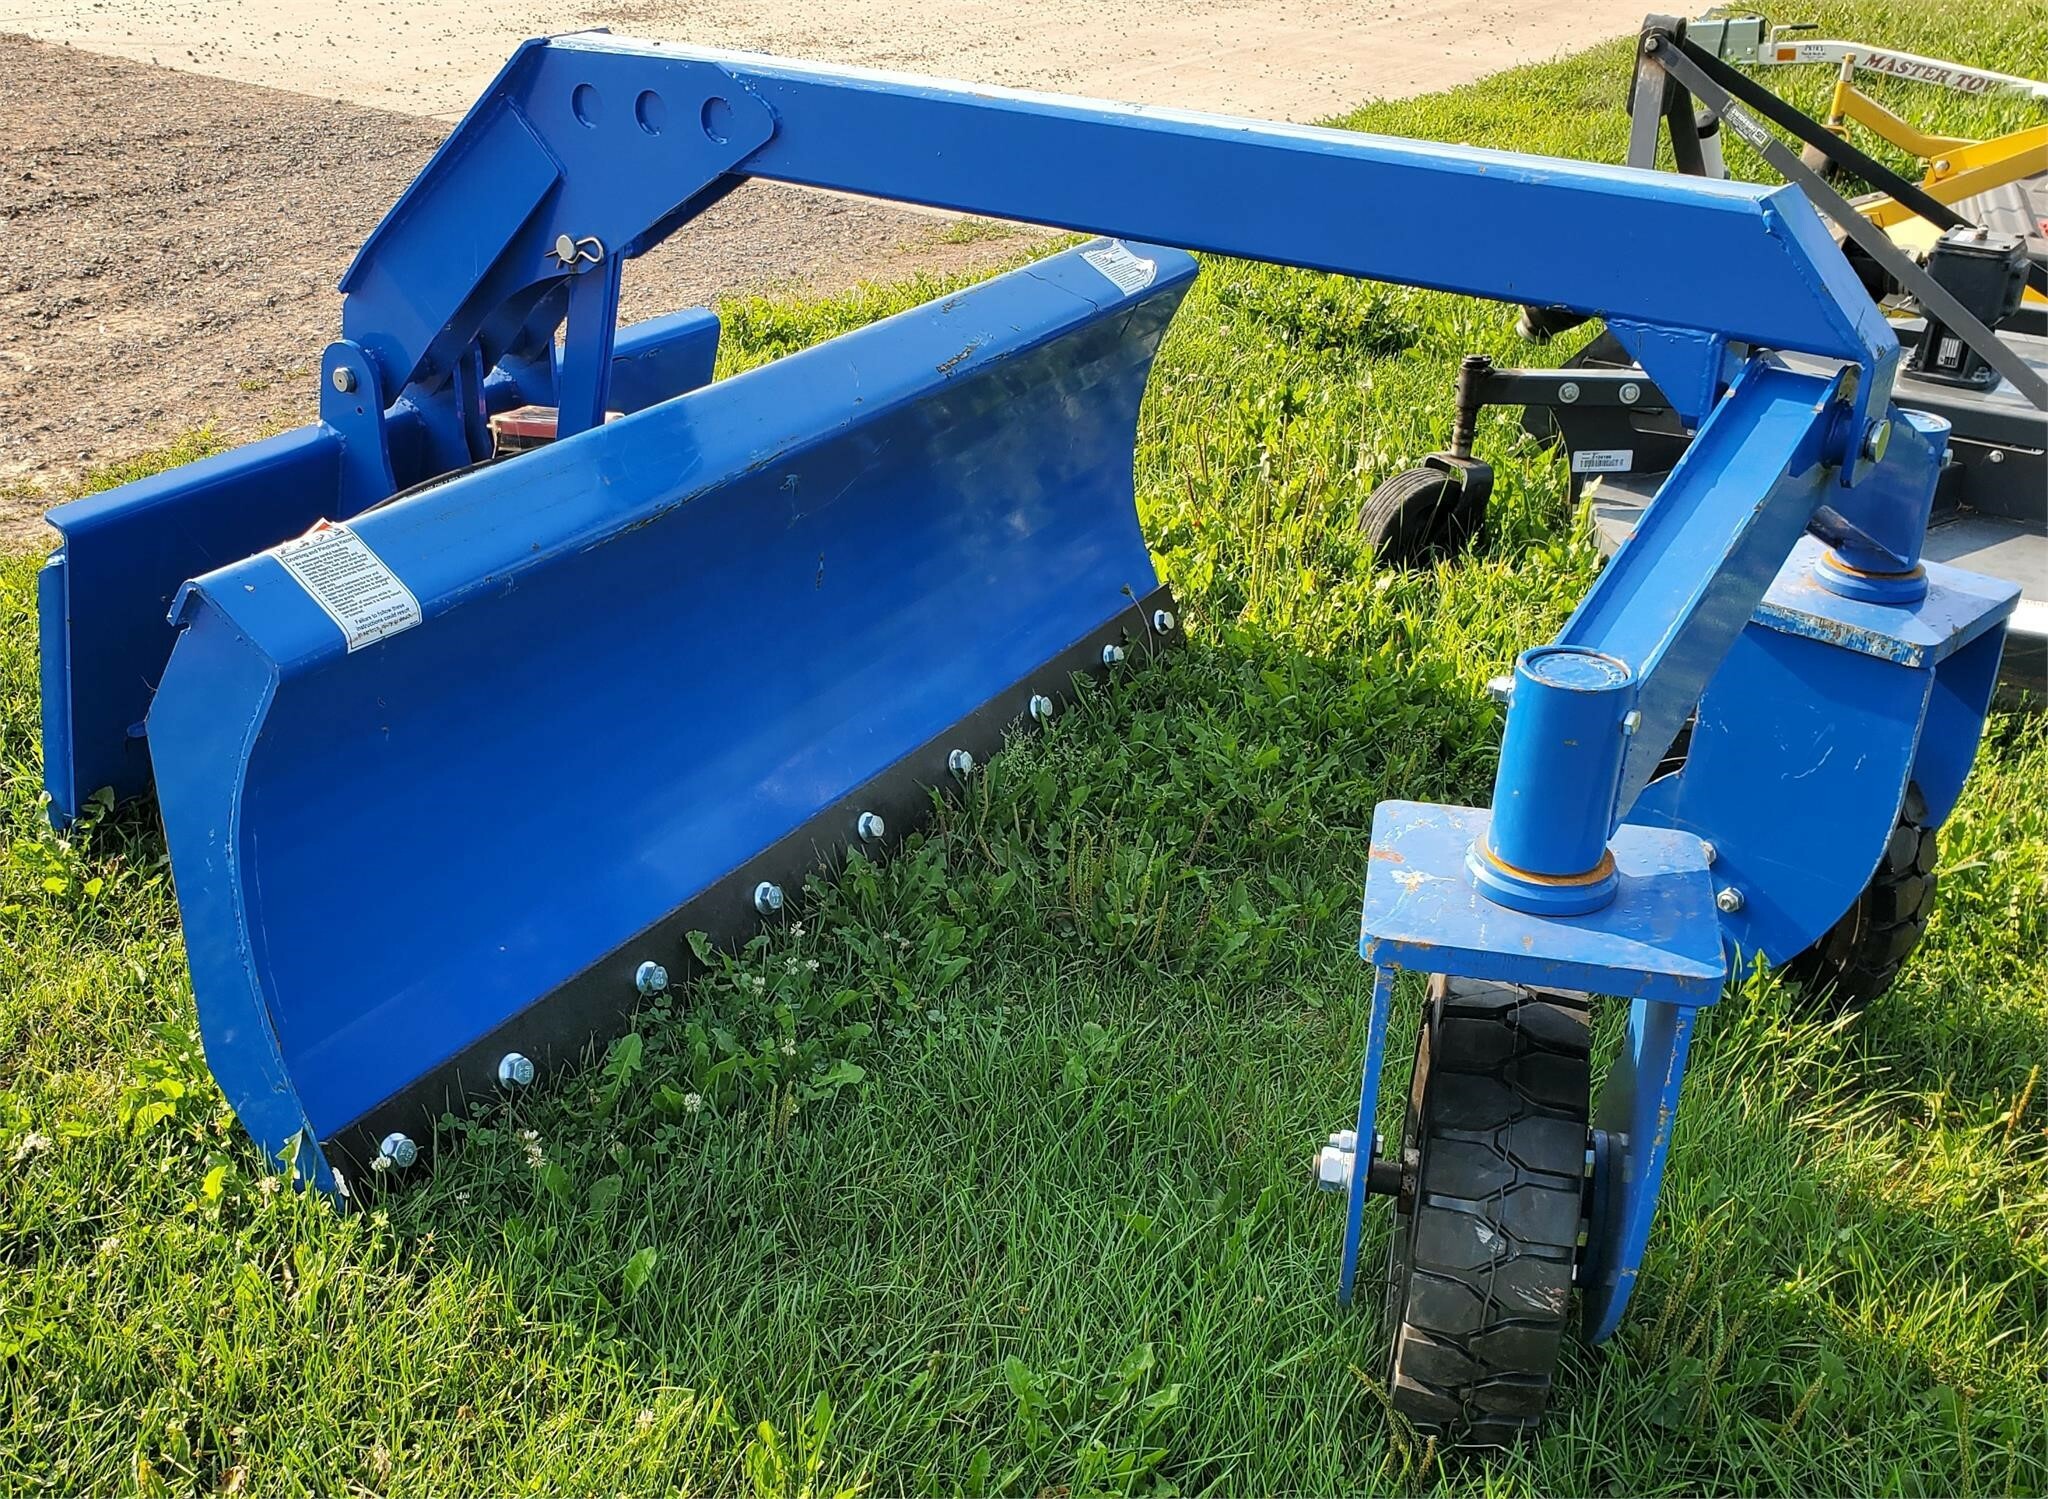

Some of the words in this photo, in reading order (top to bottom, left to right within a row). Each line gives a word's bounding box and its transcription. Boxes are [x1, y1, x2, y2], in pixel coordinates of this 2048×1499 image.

[1863, 53, 1952, 84] MASTER
[286, 552, 309, 563] Crushing
[317, 541, 339, 552] Pinching
[338, 536, 355, 544] Hazard
[354, 615, 372, 624] Failure
[355, 618, 384, 630] instructions
